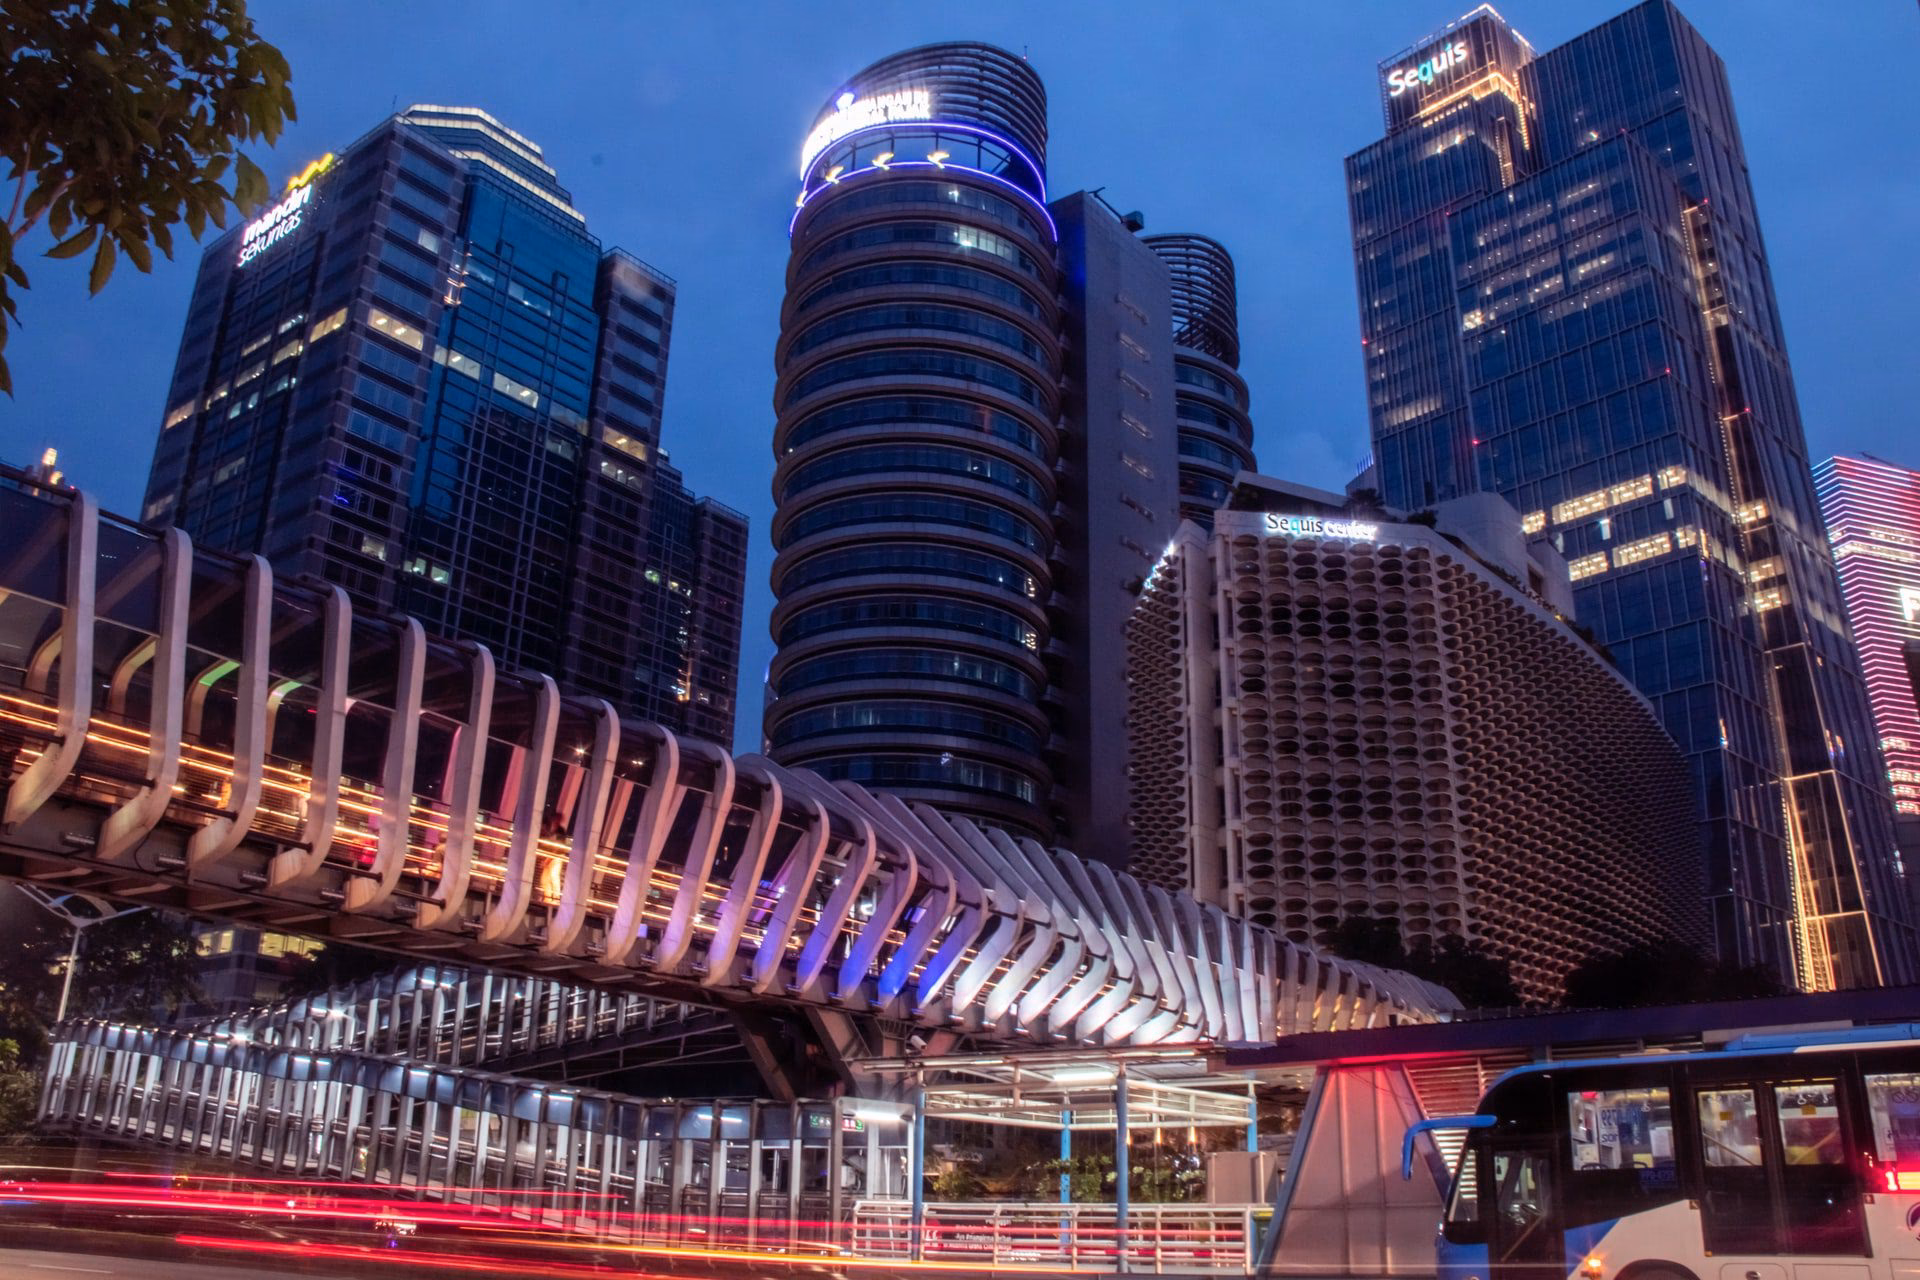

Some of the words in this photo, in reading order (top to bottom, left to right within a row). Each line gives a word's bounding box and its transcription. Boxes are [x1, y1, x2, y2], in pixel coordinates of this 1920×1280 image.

[1387, 42, 1467, 97] Sequis
[237, 210, 303, 267] sekuritas
[1266, 512, 1324, 535] Sequis
